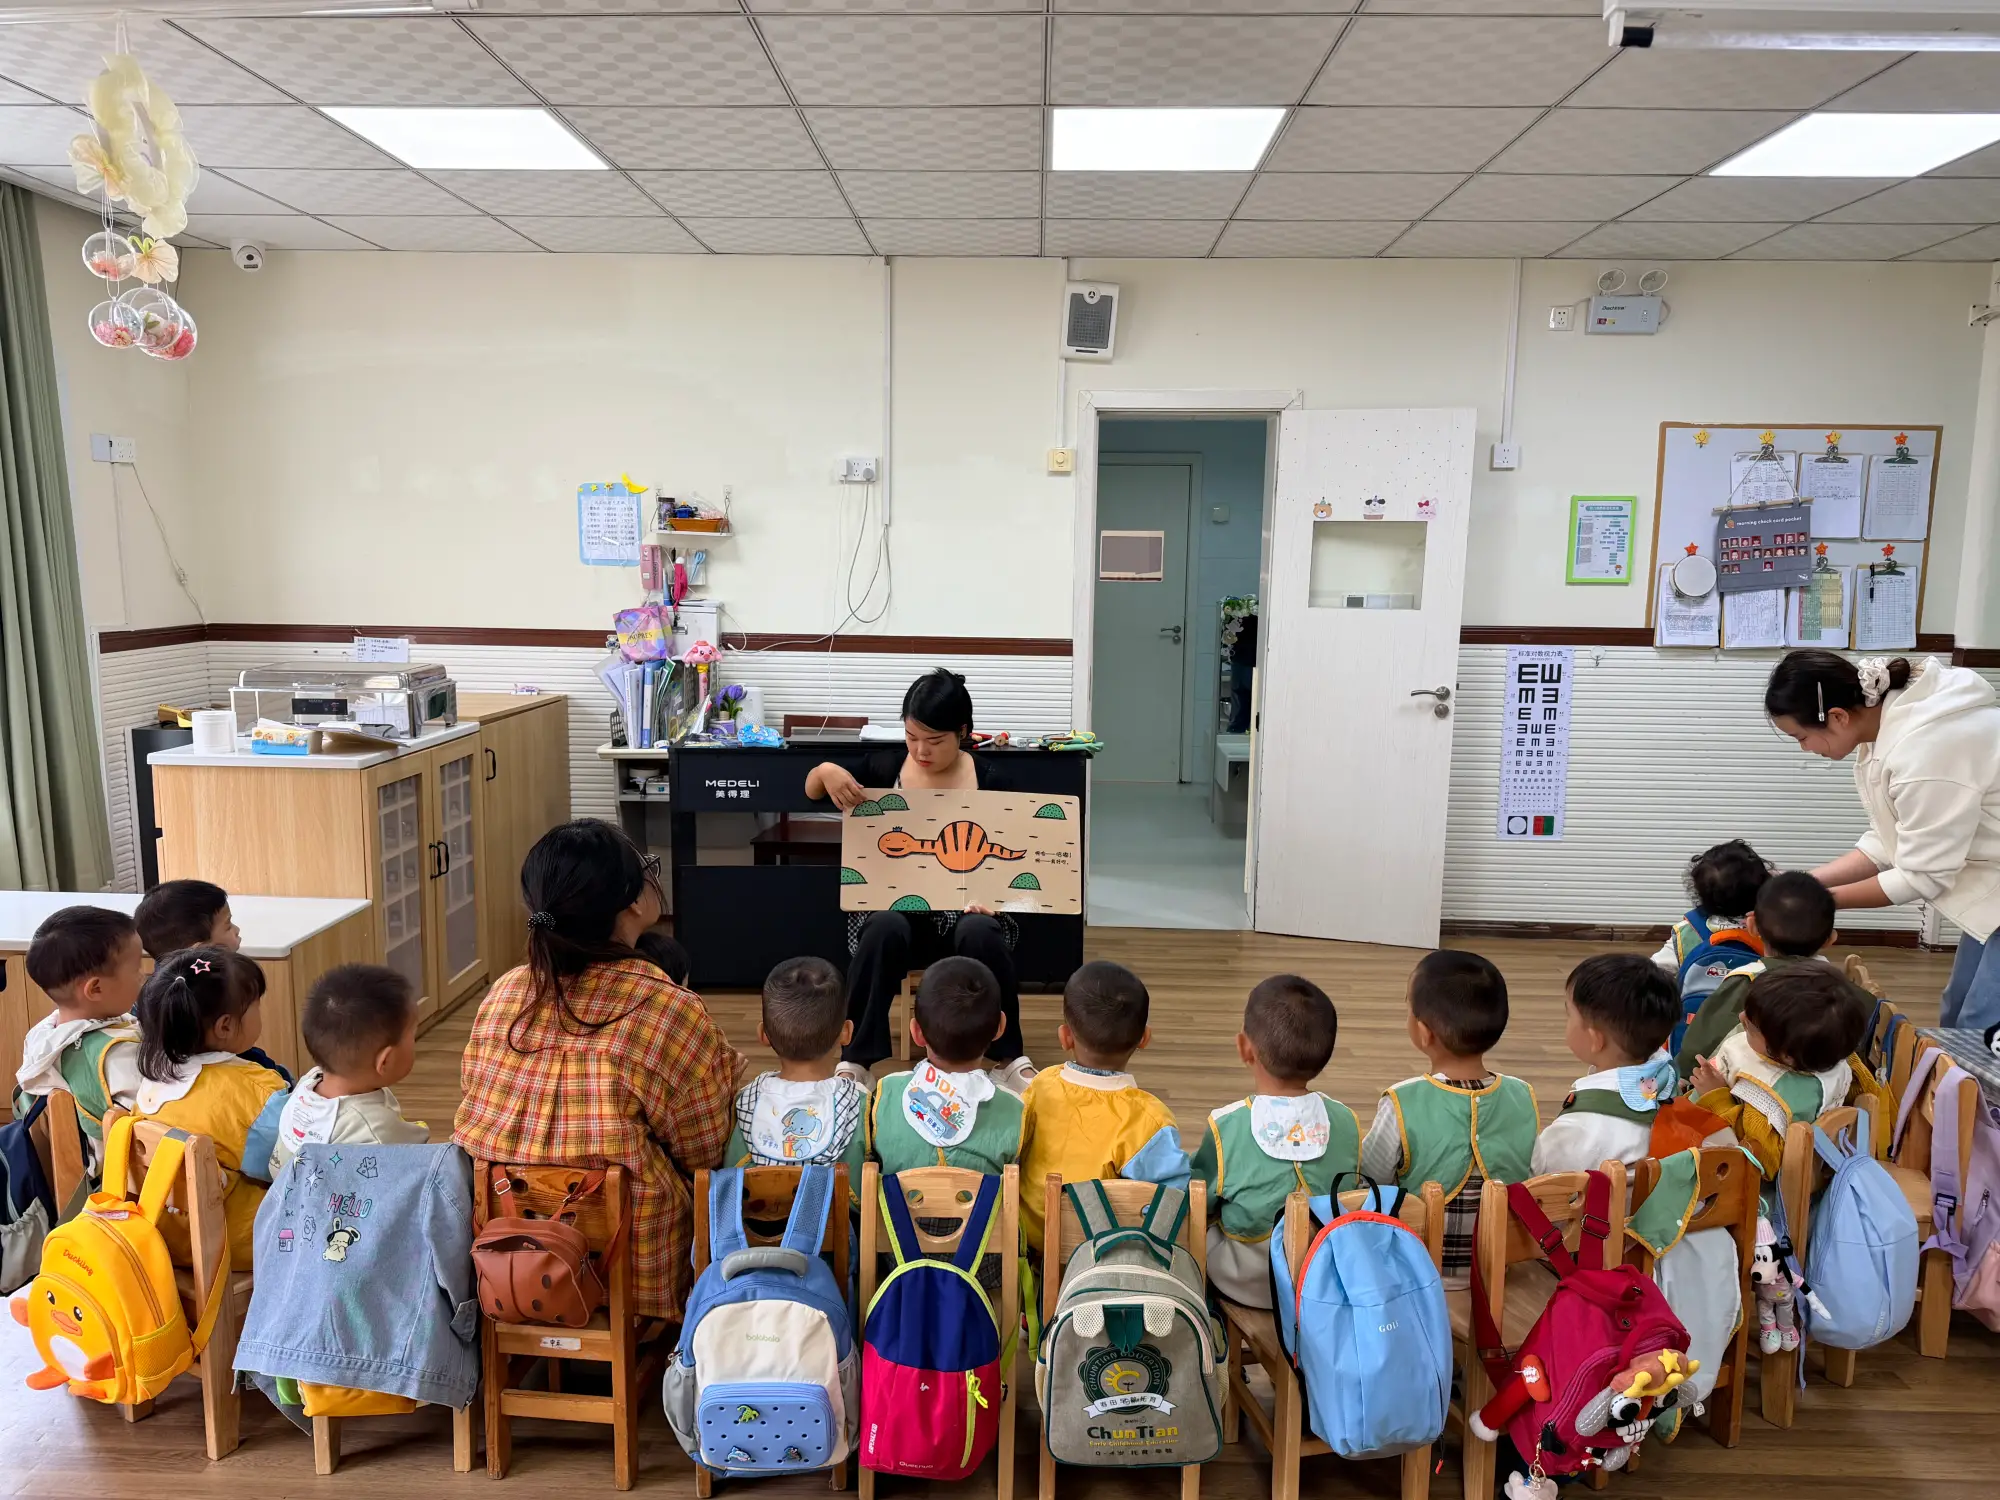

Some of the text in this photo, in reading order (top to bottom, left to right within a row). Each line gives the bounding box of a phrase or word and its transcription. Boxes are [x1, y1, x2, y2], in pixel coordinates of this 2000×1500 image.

[705, 779, 760, 788] MEDELI
[715, 790, 750, 799] 美得理
[327, 1192, 373, 1219] HELLO
[63, 1249, 94, 1277] Duckling
[1088, 1351, 1118, 1391] CHUNTIAN
[1086, 1425, 1179, 1440] ChunTian
